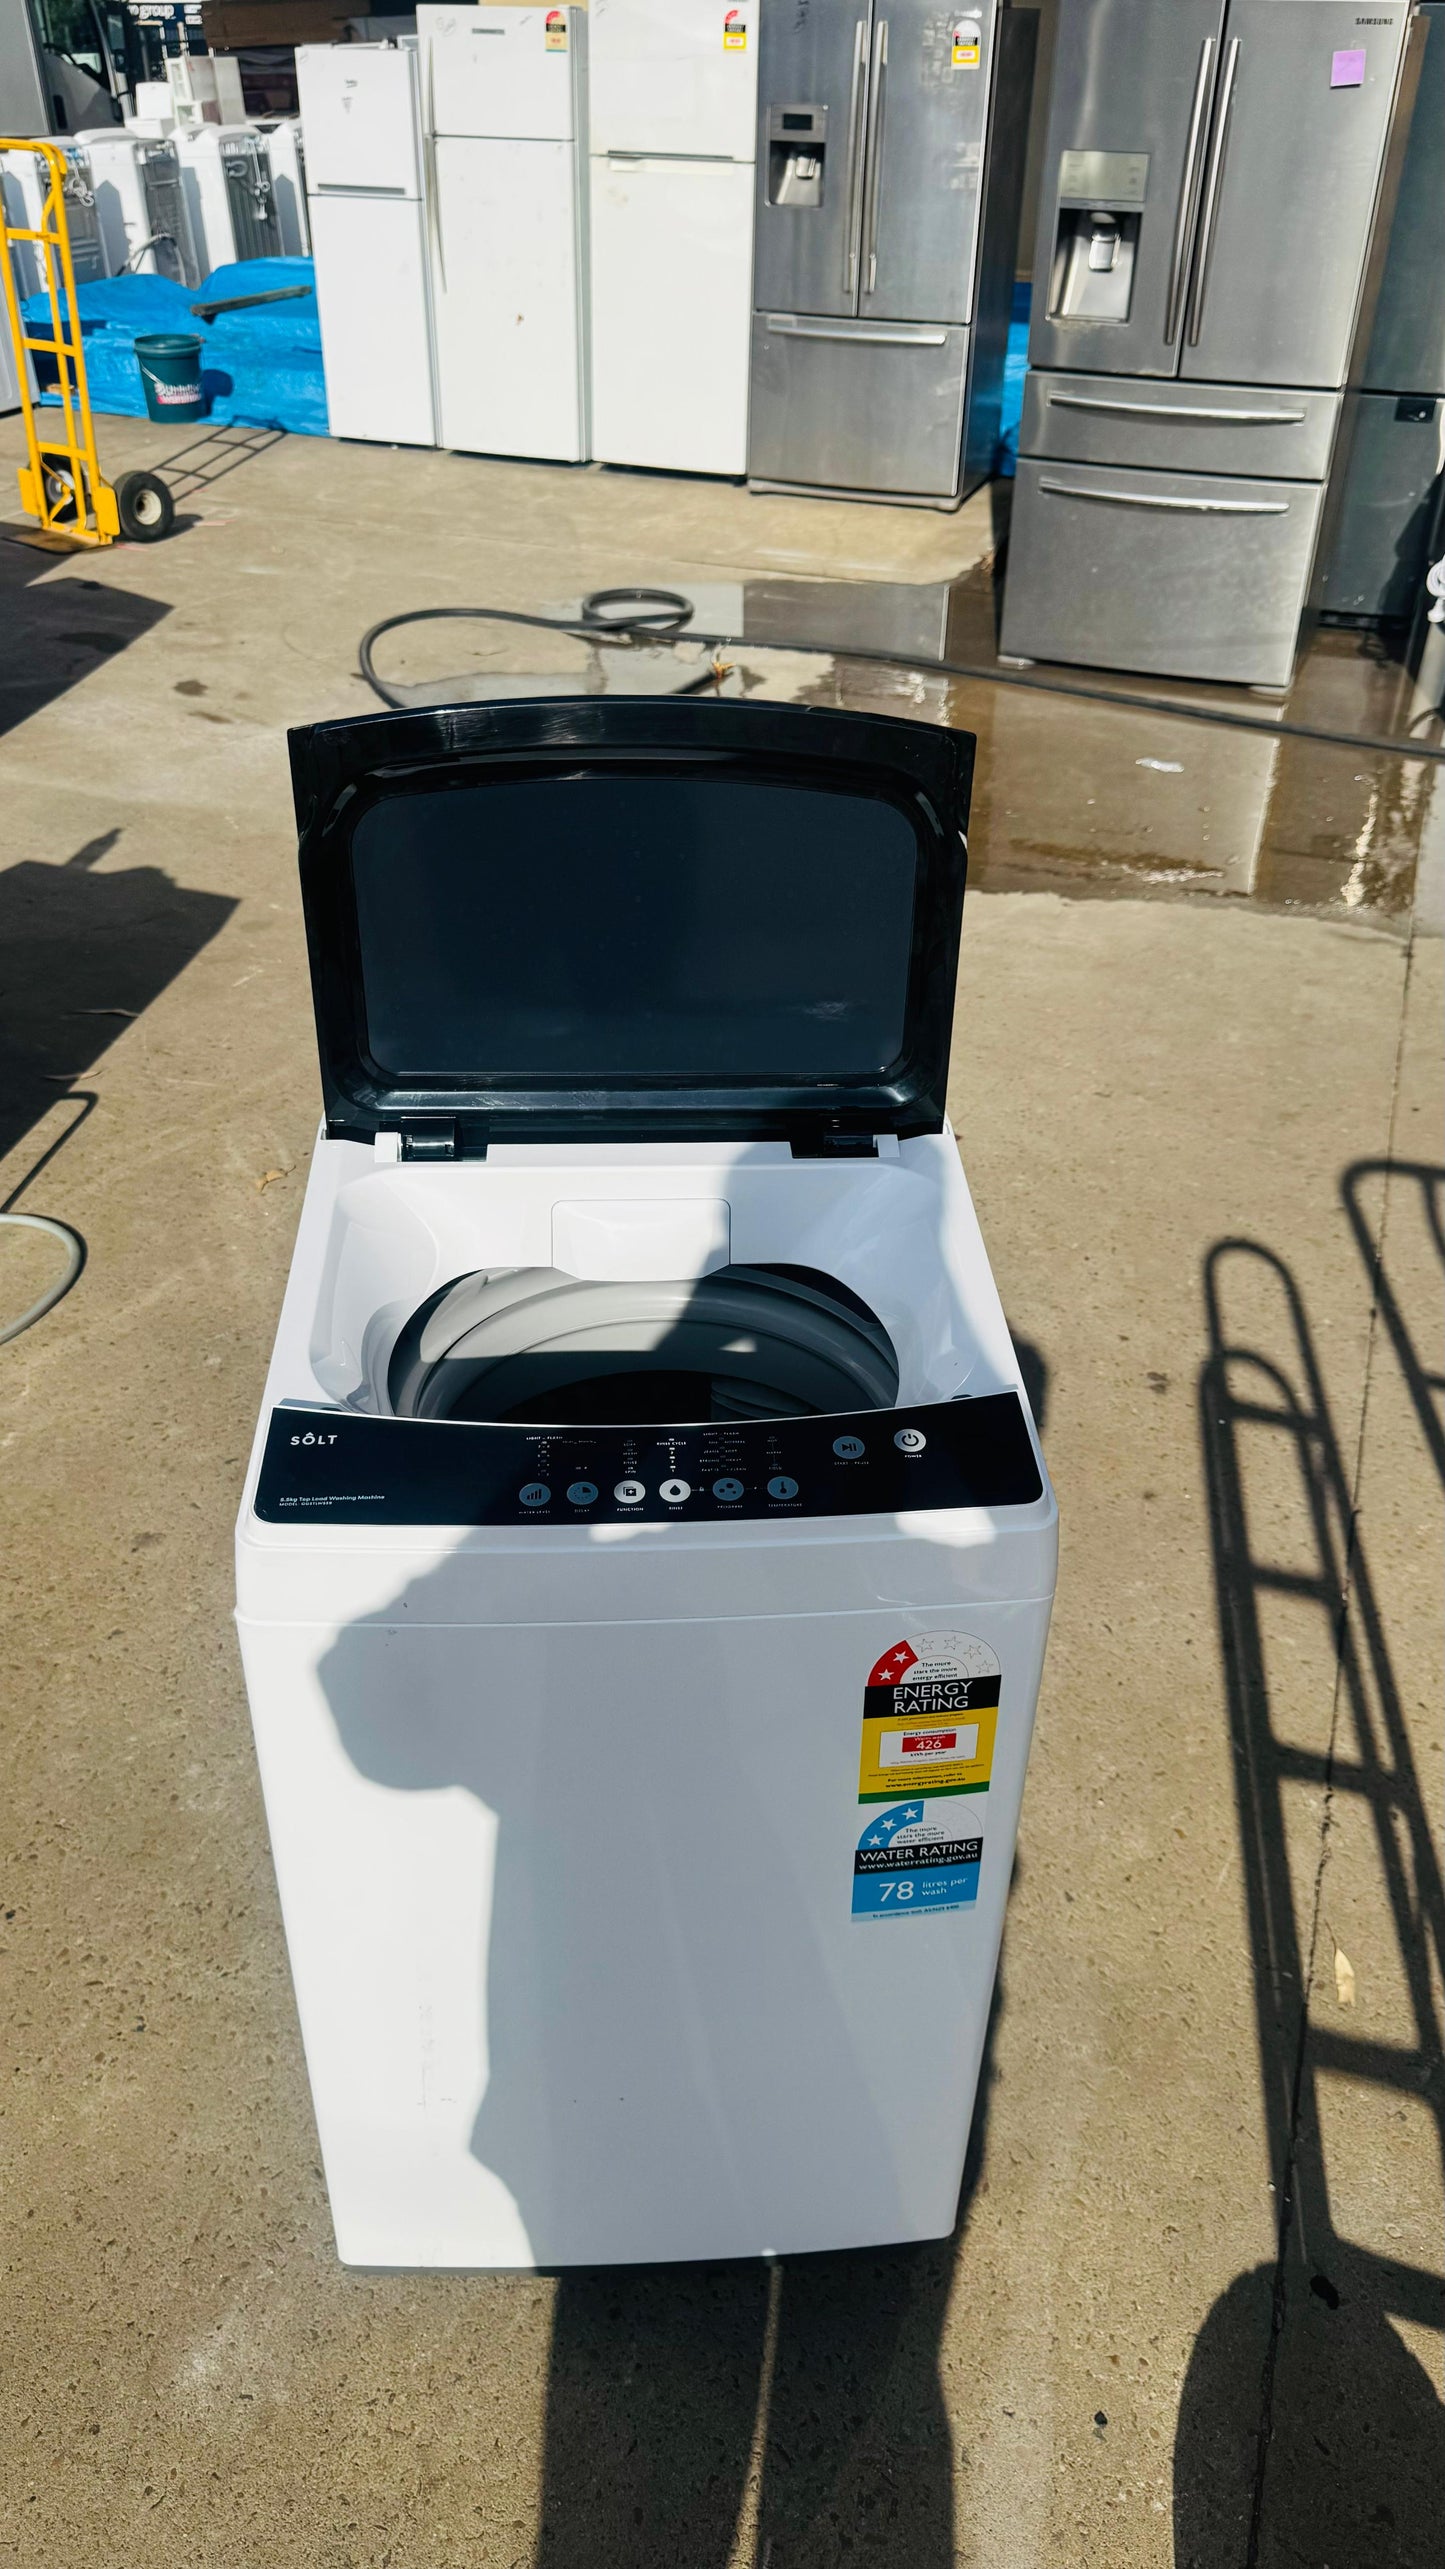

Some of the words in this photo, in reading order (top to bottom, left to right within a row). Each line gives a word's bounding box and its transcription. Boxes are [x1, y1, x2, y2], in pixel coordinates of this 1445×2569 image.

[290, 1431, 338, 1446] SÔLT
[893, 1680, 974, 1700] ENERGY
[894, 1695, 969, 1714] RATING
[916, 1739, 942, 1750] 426
[859, 1848, 914, 1862] WATER
[919, 1841, 978, 1857] RATING
[858, 1852, 978, 1870] www.waterrating.gov.au
[879, 1881, 914, 1902] 78
[921, 1887, 947, 1896] wash
[922, 1880, 947, 1889] litres
[950, 1877, 968, 1887] per
